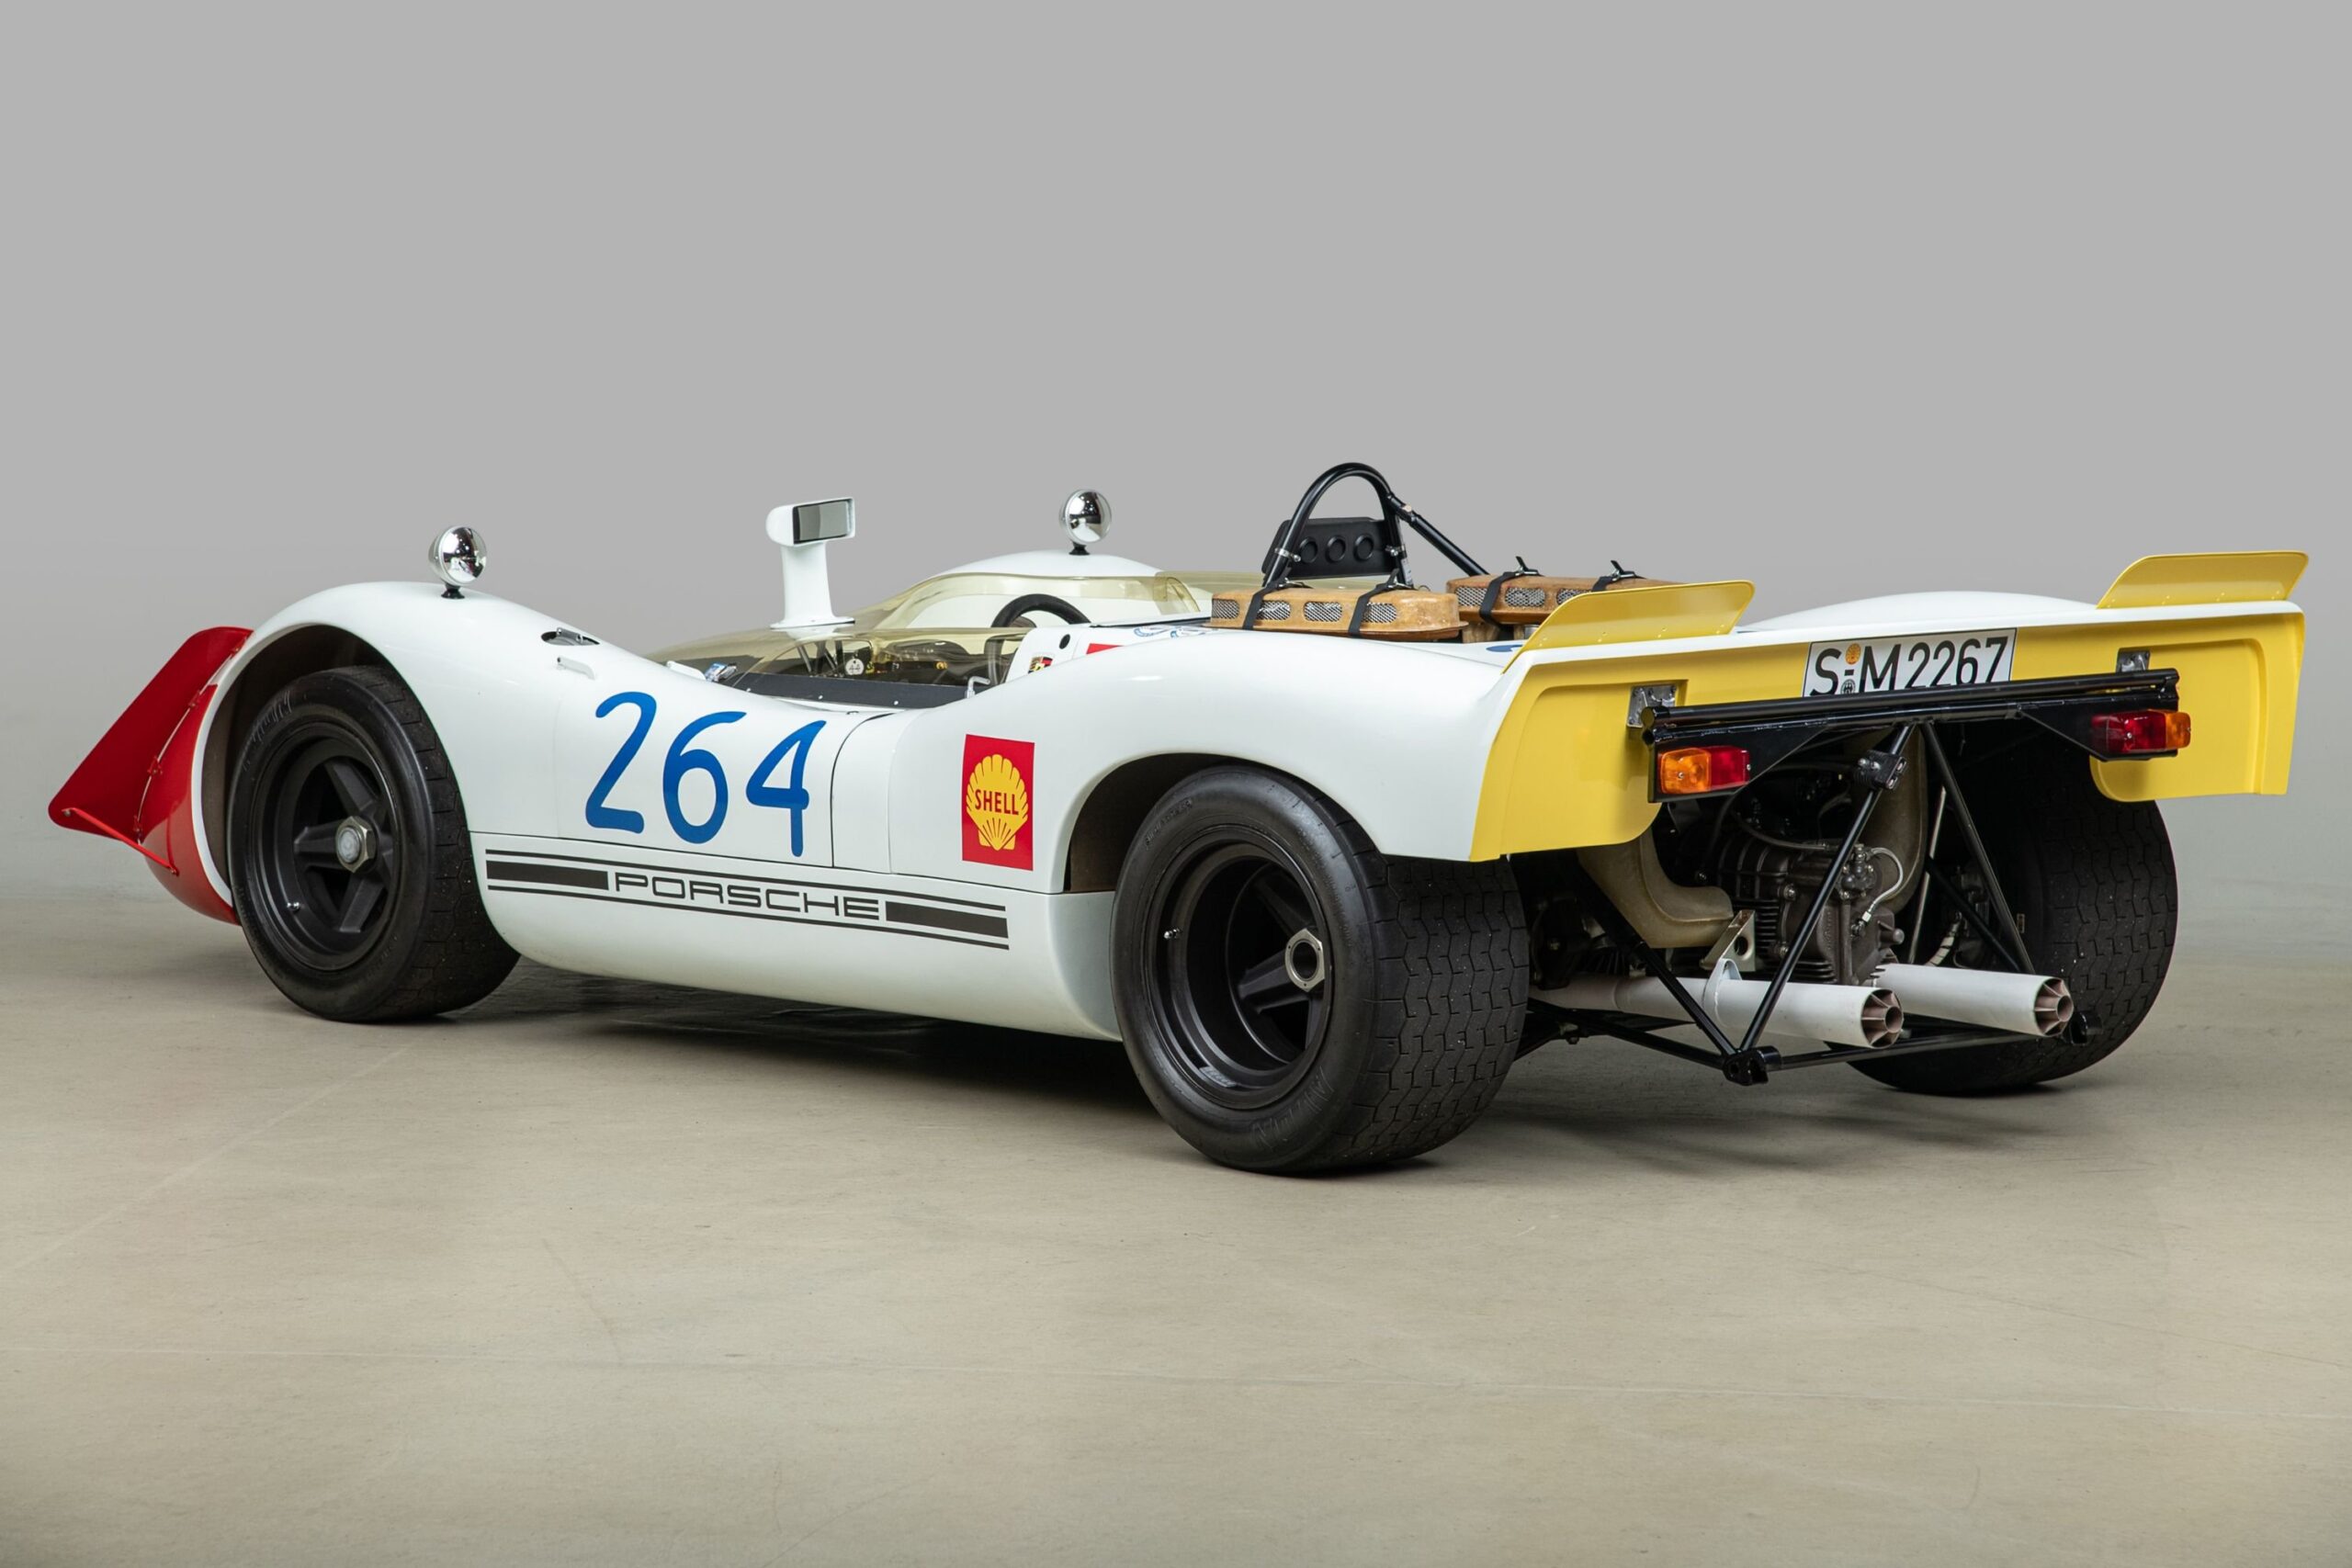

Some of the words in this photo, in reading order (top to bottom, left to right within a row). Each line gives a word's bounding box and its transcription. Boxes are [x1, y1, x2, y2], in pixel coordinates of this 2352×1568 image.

[585, 691, 827, 857] 264
[975, 788, 1020, 816] SHELL
[615, 872, 880, 920] PORSCHE
